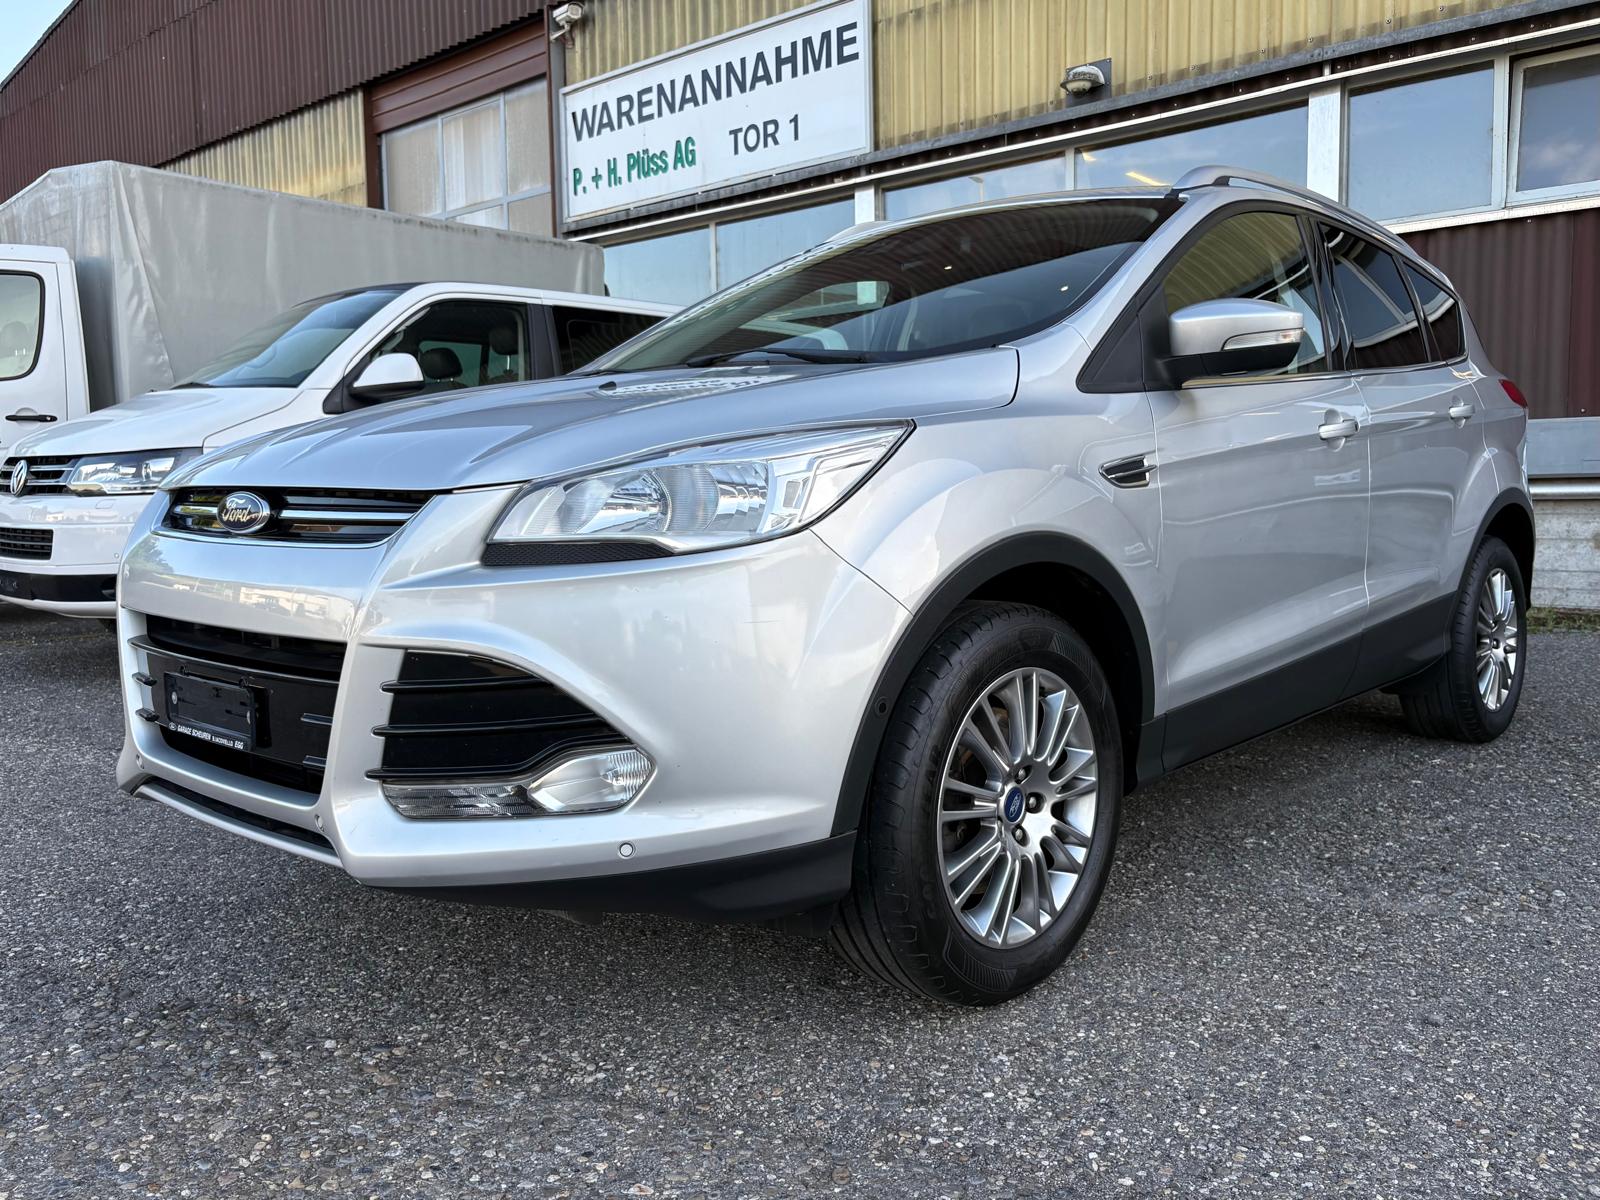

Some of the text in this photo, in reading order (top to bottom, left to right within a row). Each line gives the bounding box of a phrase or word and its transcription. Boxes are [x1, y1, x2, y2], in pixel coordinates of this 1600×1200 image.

[571, 21, 860, 143] WARENANNAHME
[728, 114, 800, 155] TOR 1
[573, 136, 697, 196] P. + H. Plüss AG
